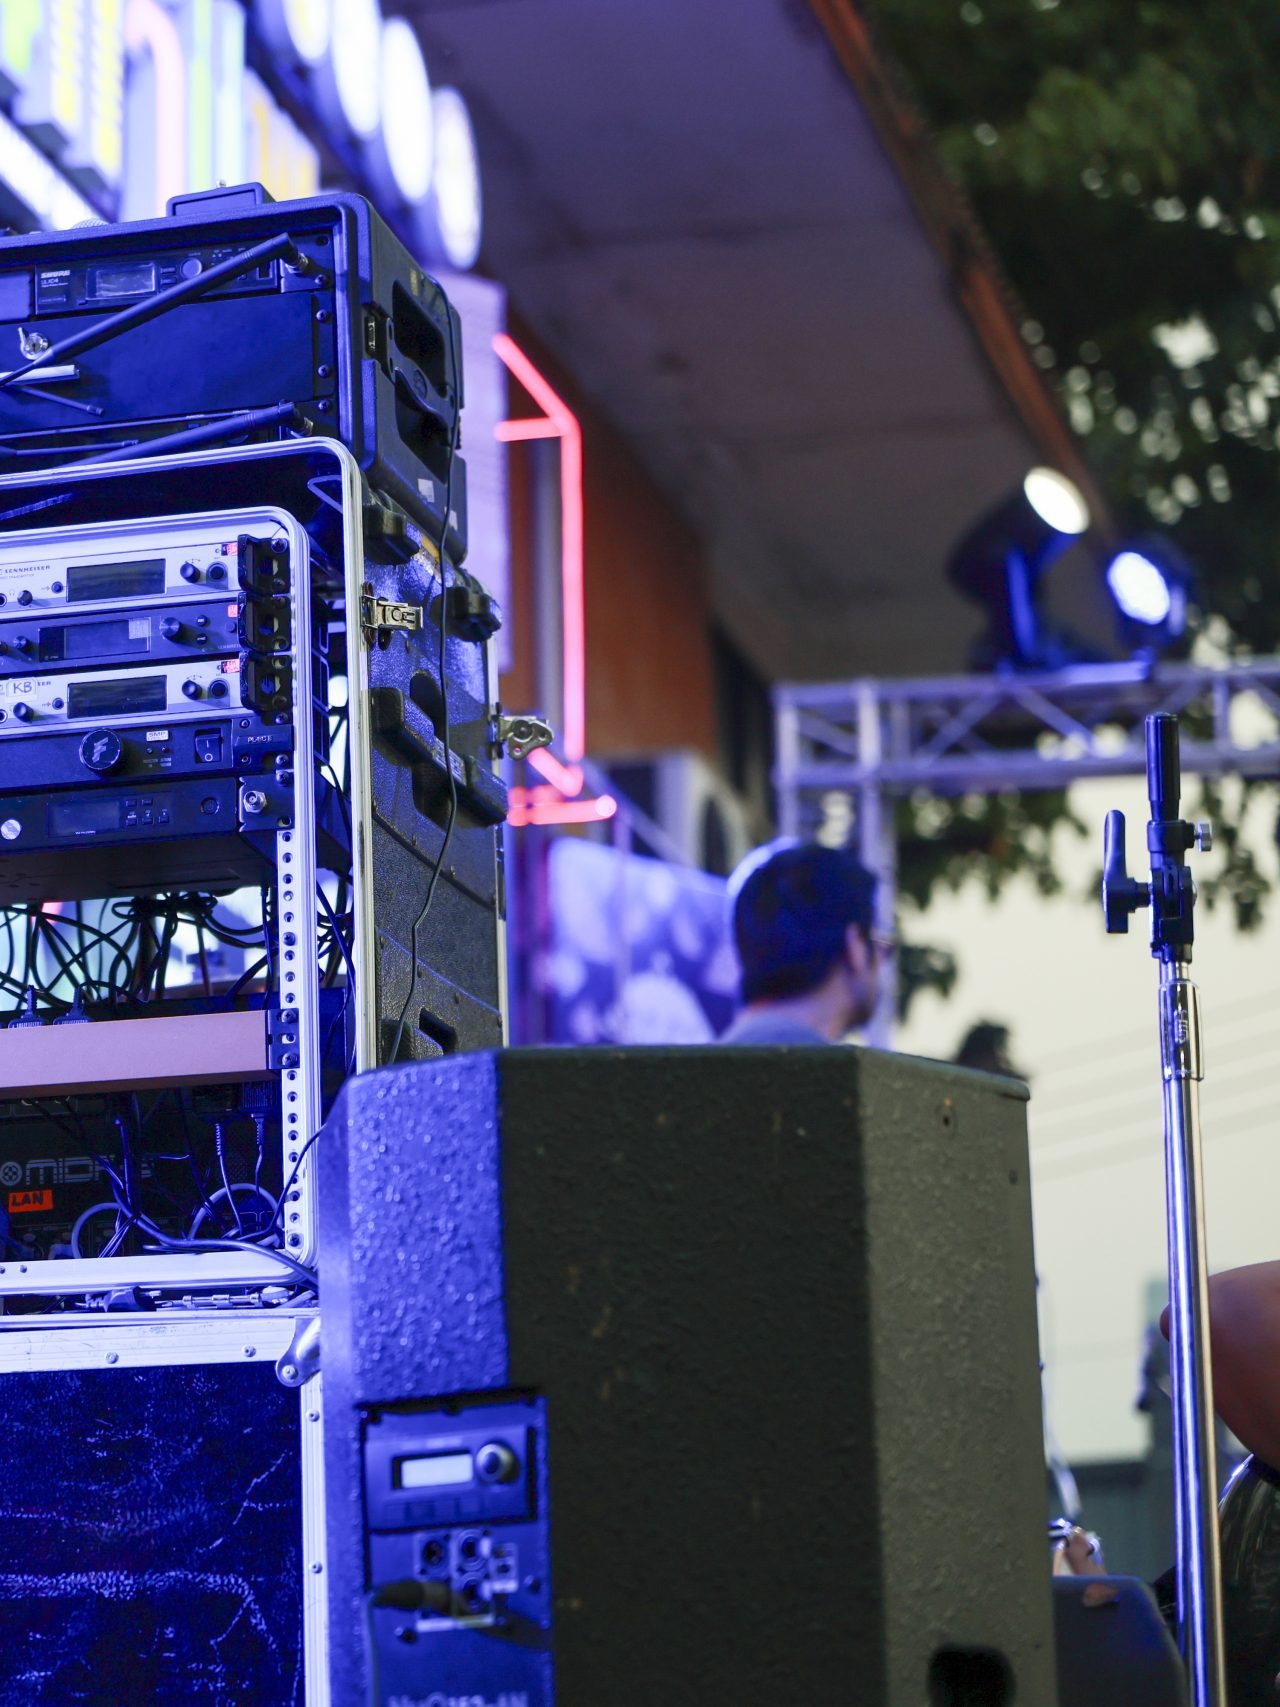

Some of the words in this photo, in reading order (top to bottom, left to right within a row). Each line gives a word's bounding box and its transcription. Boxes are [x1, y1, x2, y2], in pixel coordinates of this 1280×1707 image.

[41, 270, 70, 278] SHURE
[5, 565, 51, 574] SENNHEISER
[13, 681, 32, 694] KB
[12, 1192, 44, 1206] LAN
